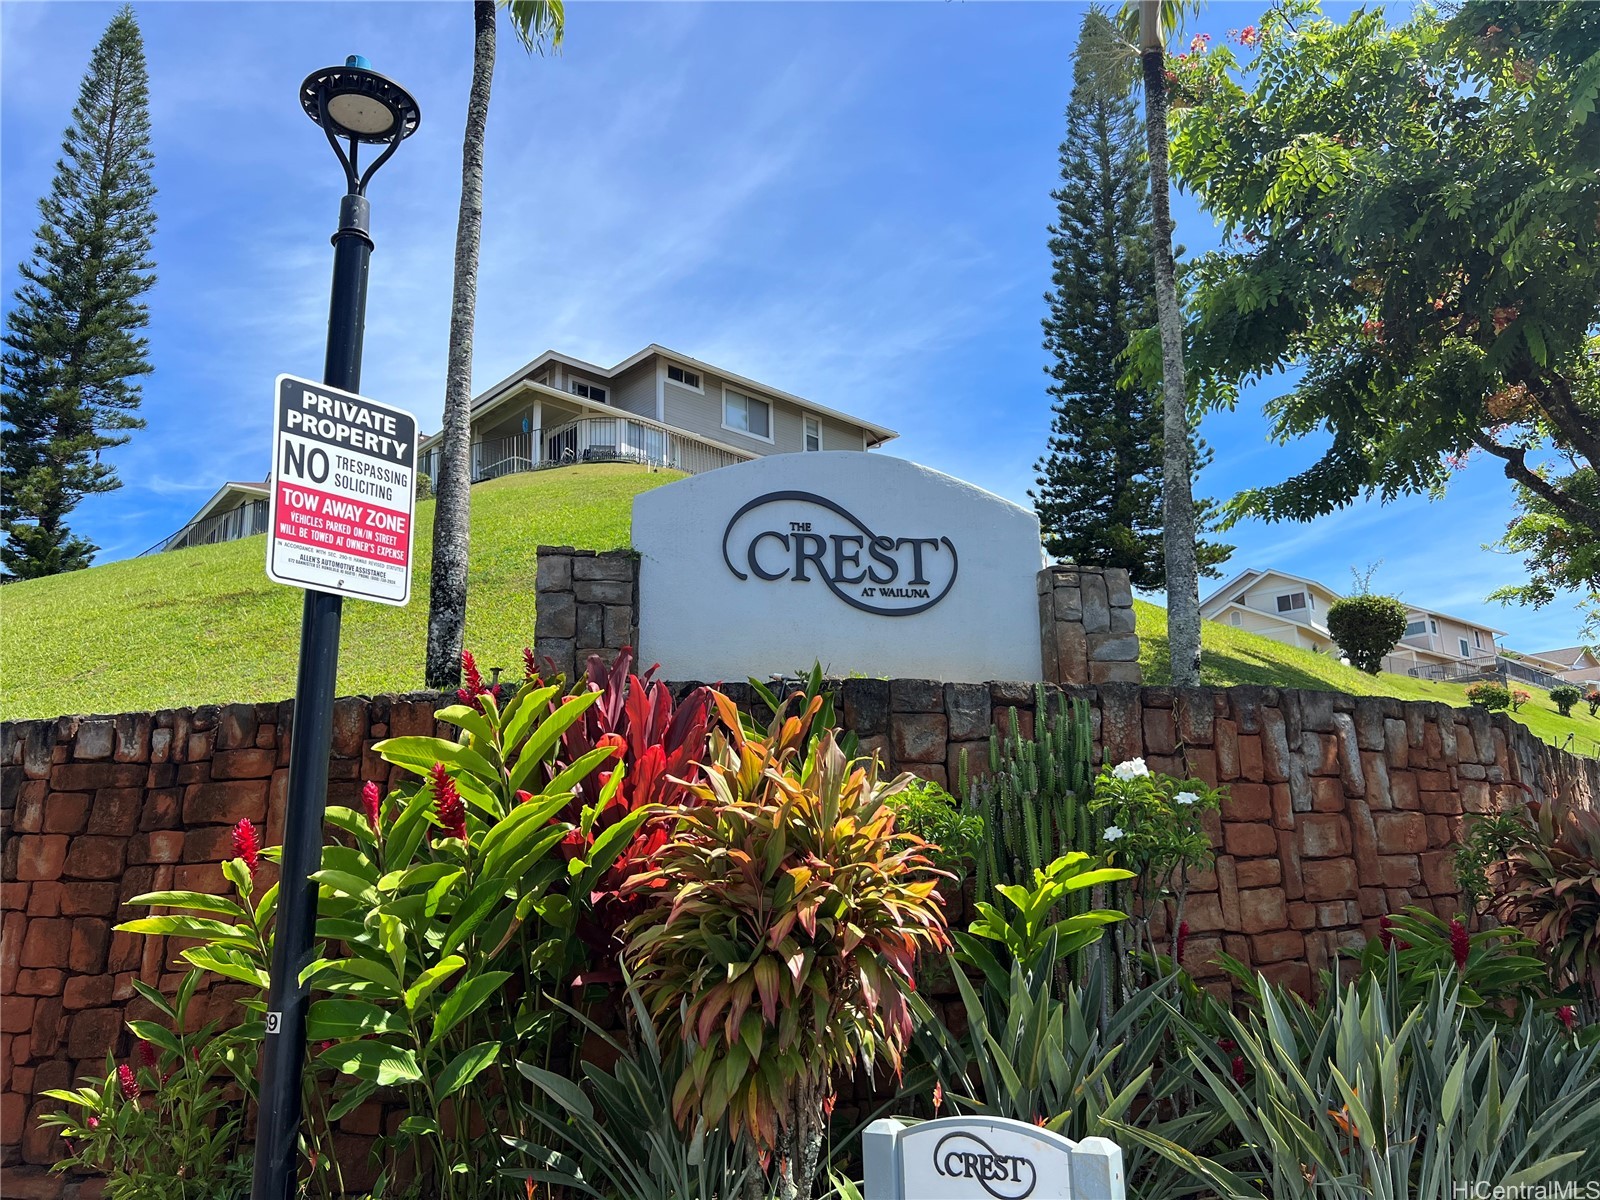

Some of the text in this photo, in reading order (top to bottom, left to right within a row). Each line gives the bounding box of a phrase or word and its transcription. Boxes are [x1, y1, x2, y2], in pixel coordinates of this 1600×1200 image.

[302, 390, 397, 436] PRIVATE
[287, 408, 408, 460] PROPERTY
[283, 439, 330, 484] NO
[335, 454, 408, 488] TRESPASSING
[334, 473, 393, 501] SOLICITING
[282, 487, 406, 534] TOW AWAY ZONE
[789, 522, 812, 533] THE
[280, 522, 404, 561] WILL BE TOWED AT OWNER'S EXPENSE
[290, 511, 397, 546] VEHICLES PARKED ON/IN STREET
[284, 542, 314, 553] ACCORDANCE
[368, 560, 385, 569] REVISED
[386, 564, 404, 573] STATUTES
[299, 554, 387, 579] ALLEN'S AUTOMOTIVE ASSISTANCE
[747, 531, 940, 586] CREST
[861, 587, 930, 599] AT WAILUNA
[944, 1151, 1026, 1182] CREST
